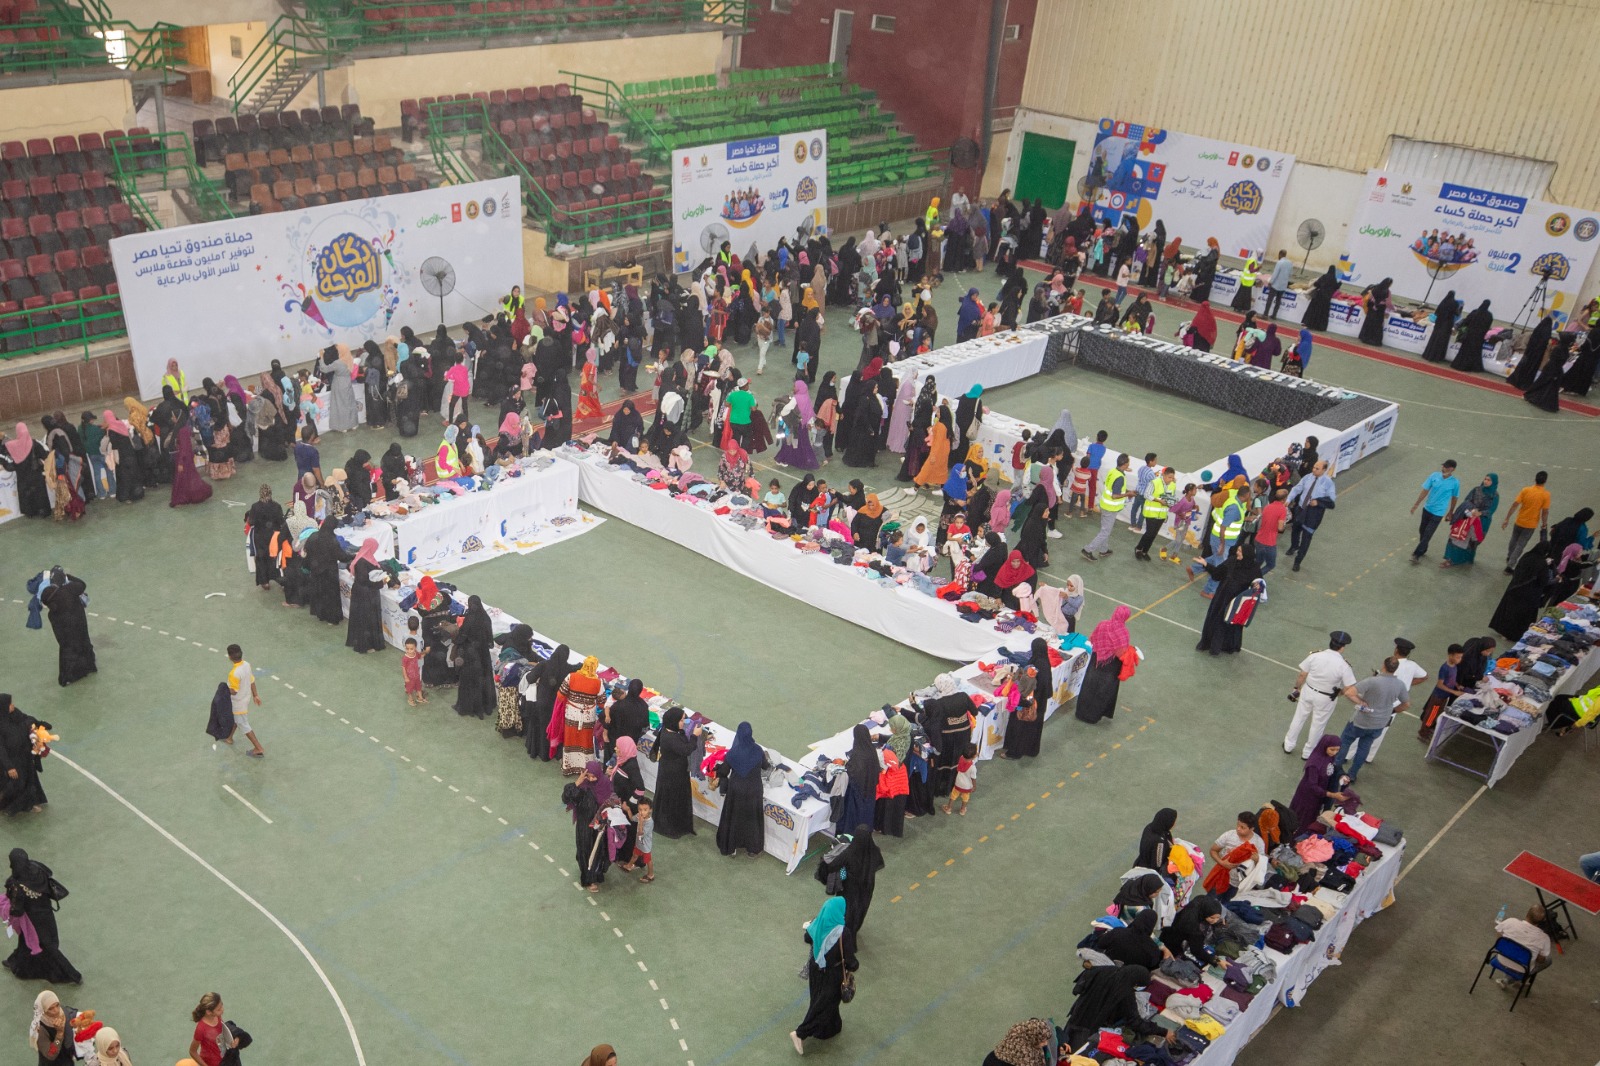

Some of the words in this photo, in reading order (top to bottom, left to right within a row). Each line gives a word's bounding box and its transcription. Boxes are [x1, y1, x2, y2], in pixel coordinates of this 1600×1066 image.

[731, 148, 743, 158] مصر
[727, 162, 748, 175] كساء
[749, 160, 765, 172] حملة
[782, 187, 789, 209] 2
[1447, 190, 1468, 199] مصر
[1469, 192, 1488, 203] تحيا
[1487, 195, 1520, 210] صندوق
[1434, 204, 1466, 218] كساء
[1468, 209, 1493, 223] حملة
[1494, 215, 1520, 228] أكبر
[185, 236, 224, 254] صندوق
[225, 231, 253, 245] حملة
[132, 248, 158, 263] مصر
[160, 241, 182, 259] تحيا
[229, 246, 255, 260] لتوفير
[1487, 249, 1510, 260] مليون
[135, 262, 166, 277] ملابس
[167, 256, 193, 270] قطعة
[218, 263, 240, 277] للأسر
[1504, 253, 1522, 274] 2
[157, 272, 191, 288] بالرعاية
[193, 267, 216, 281] الأولى
